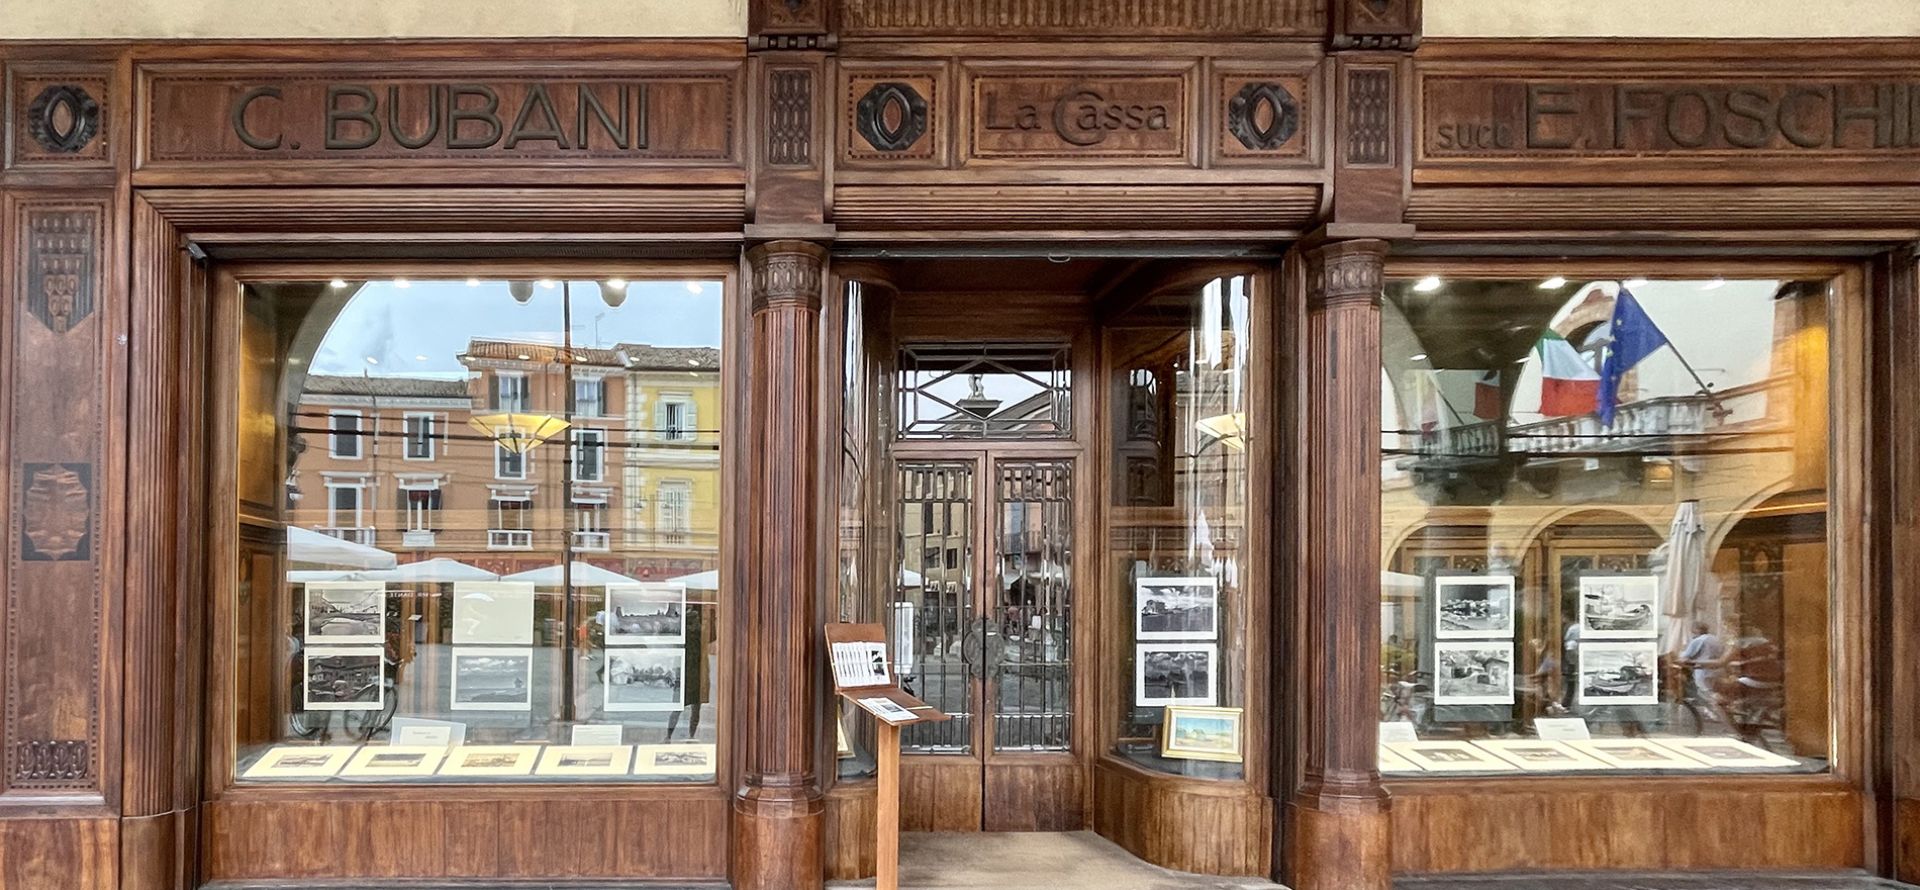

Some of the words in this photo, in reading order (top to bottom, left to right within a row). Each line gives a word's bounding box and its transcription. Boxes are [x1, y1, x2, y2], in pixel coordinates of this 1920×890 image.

[233, 88, 300, 150] C.
[324, 85, 649, 150] BUBANI
[986, 92, 1041, 130] La
[1052, 90, 1169, 146] Cassa
